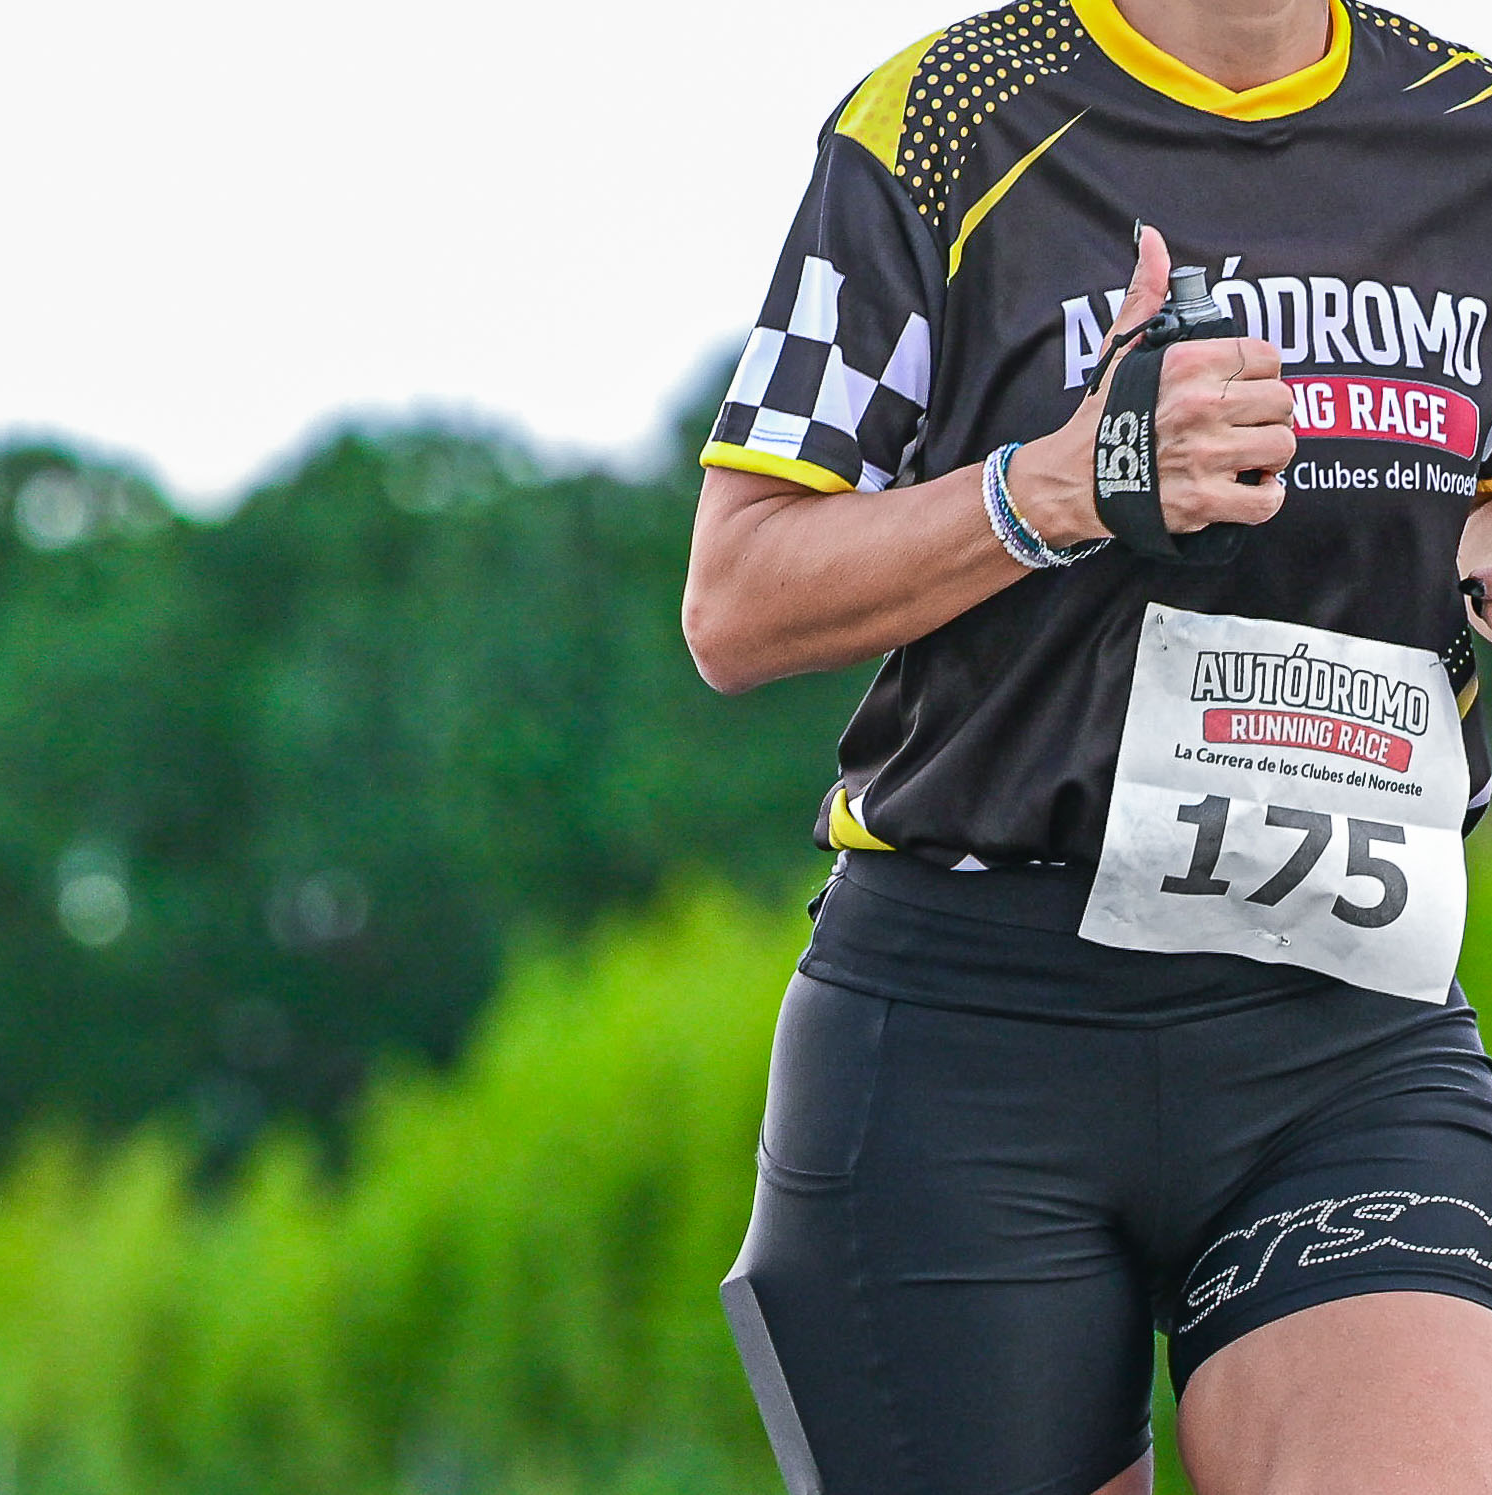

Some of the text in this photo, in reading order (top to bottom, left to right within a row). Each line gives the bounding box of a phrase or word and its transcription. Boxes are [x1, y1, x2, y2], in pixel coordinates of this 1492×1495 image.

[1061, 256, 1488, 390] AÓDROMO
[1346, 383, 1447, 445] RACE
[1097, 410, 1141, 499] 155
[1293, 461, 1378, 490] Clubes
[1385, 461, 1420, 490] del
[1190, 643, 1429, 736] AUTÓDROMO
[1174, 743, 1423, 798] La Carrera de los Clubes del Noroeste
[1230, 713, 1392, 765] RUNNING RACE
[1160, 794, 1408, 929] 175
